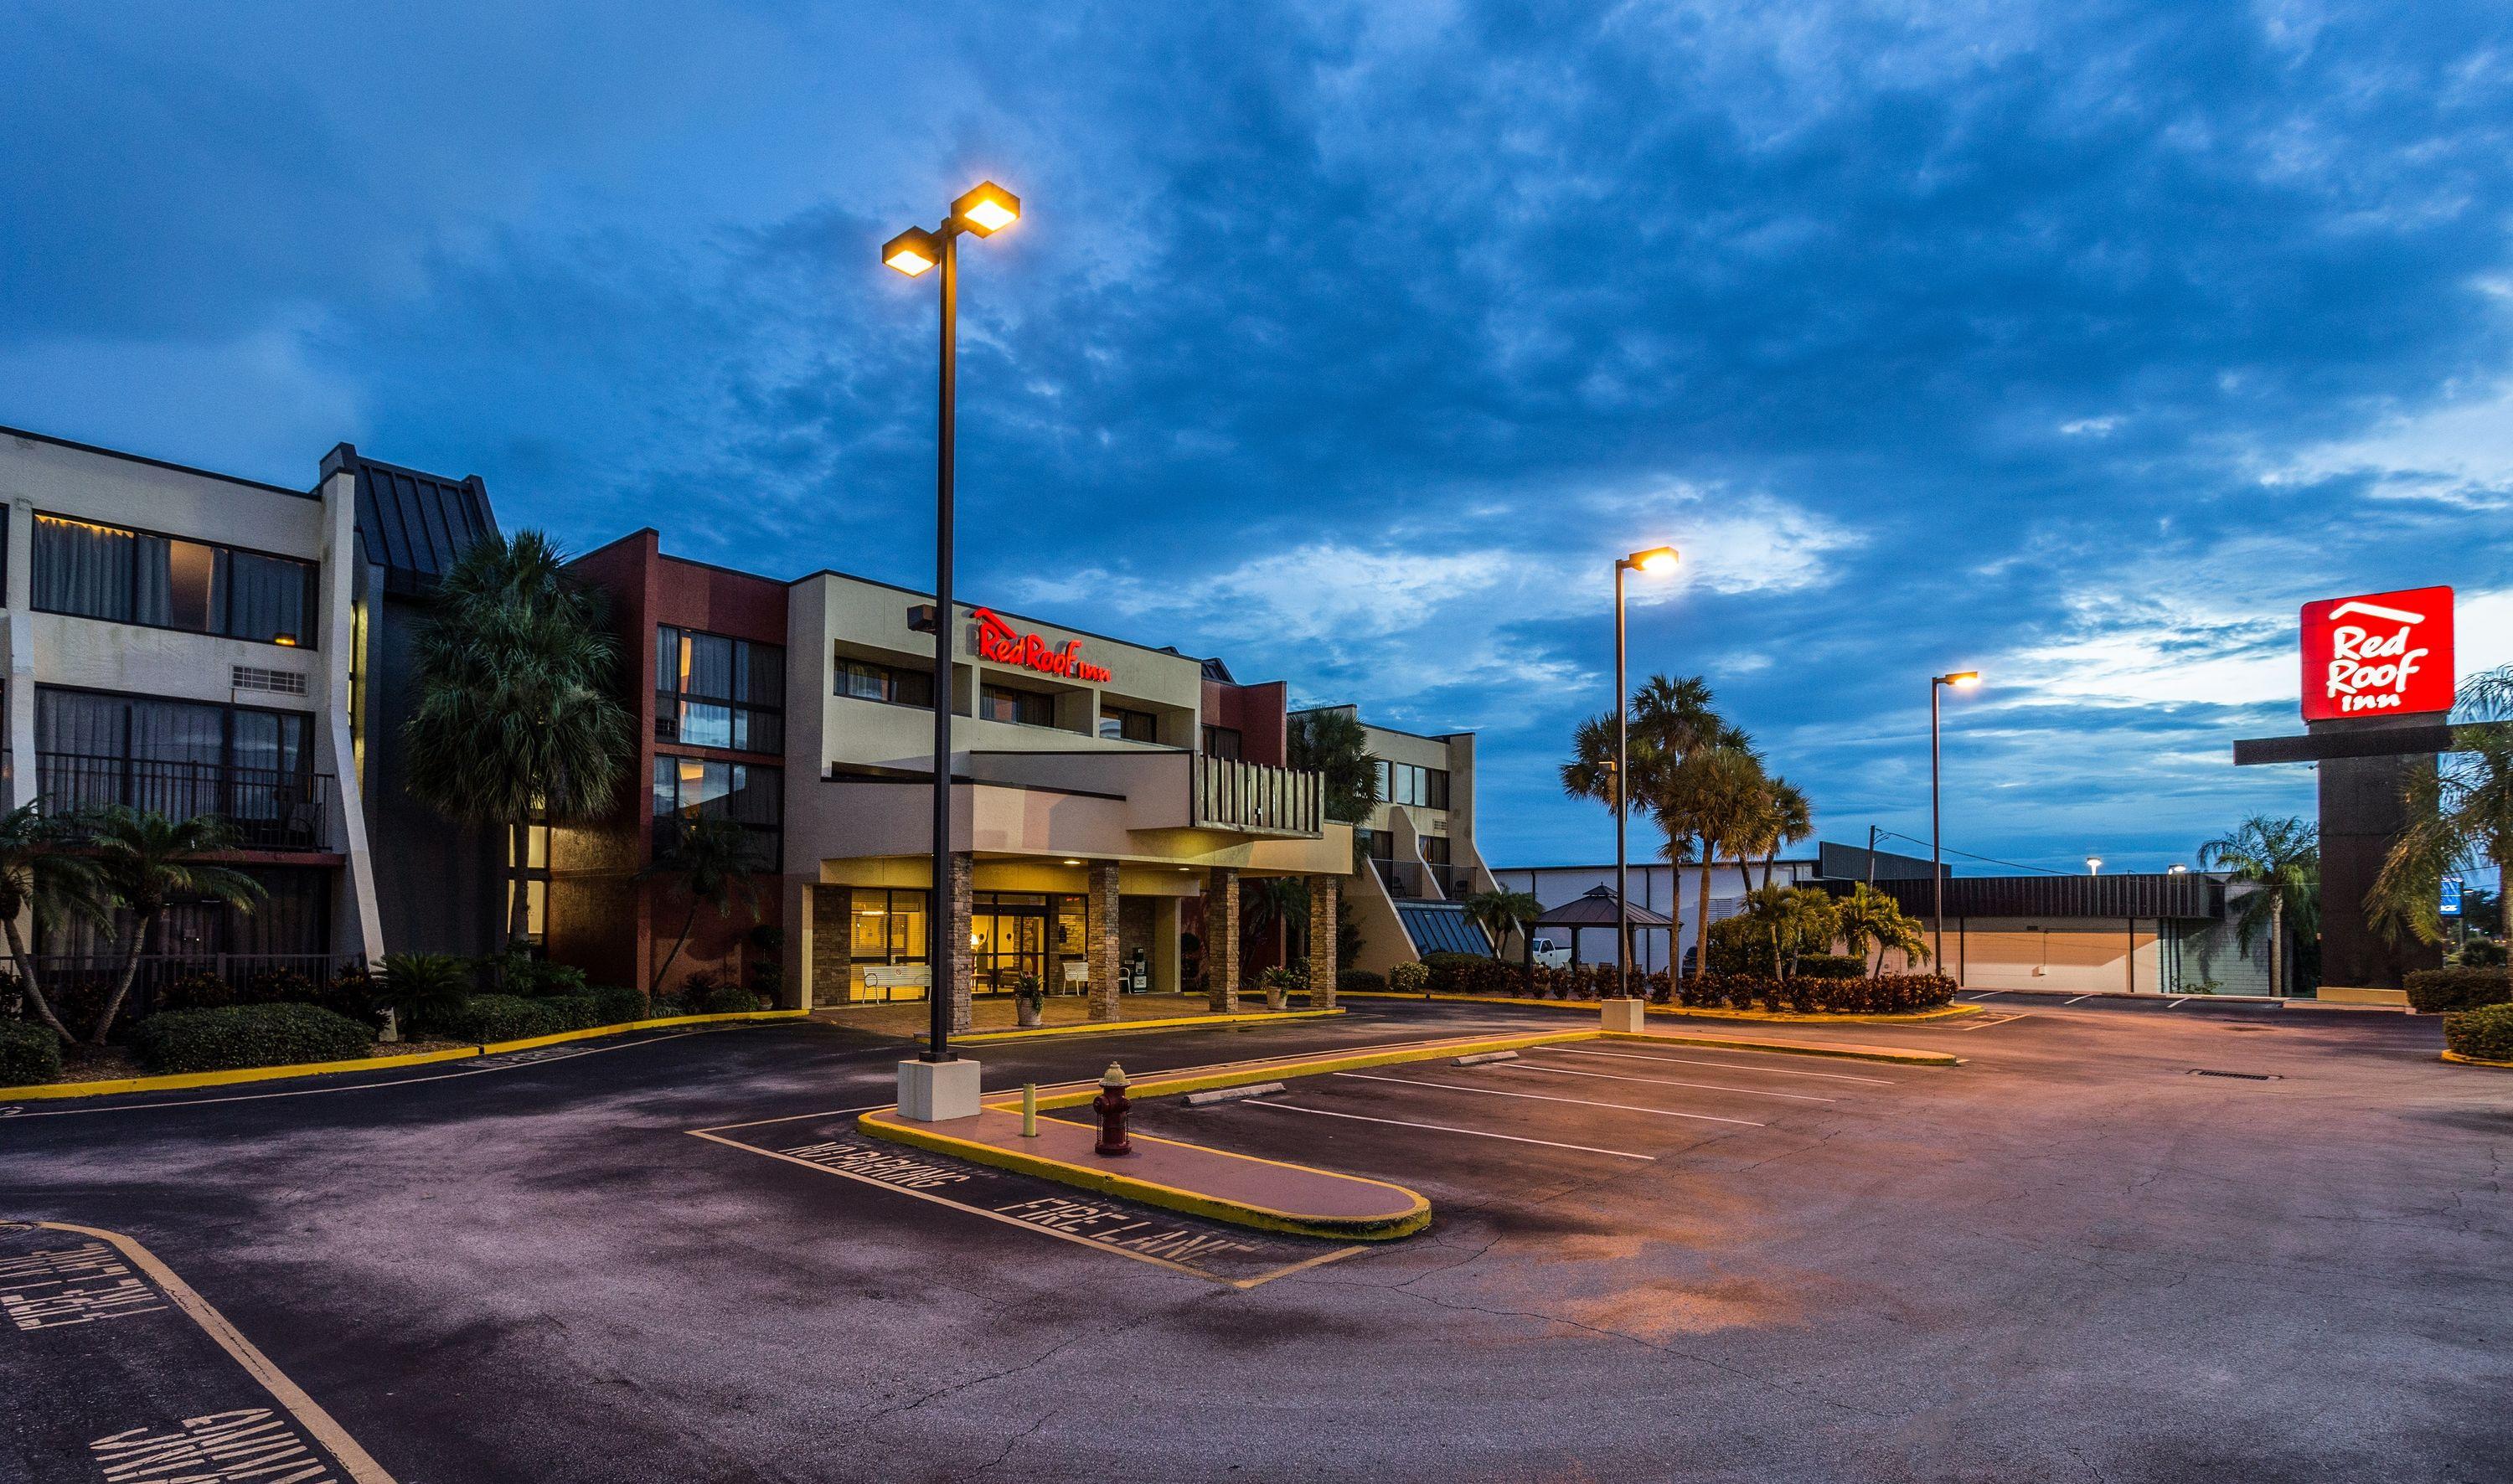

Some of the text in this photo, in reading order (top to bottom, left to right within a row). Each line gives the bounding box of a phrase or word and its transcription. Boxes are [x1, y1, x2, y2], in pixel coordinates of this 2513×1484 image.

[978, 622, 1025, 665] Red
[1024, 632, 1082, 678] Roof
[2333, 626, 2411, 661] Red
[2325, 647, 2428, 698] Roof
[777, 1141, 971, 1188] NO PARKING
[993, 1198, 1131, 1232] FIRE
